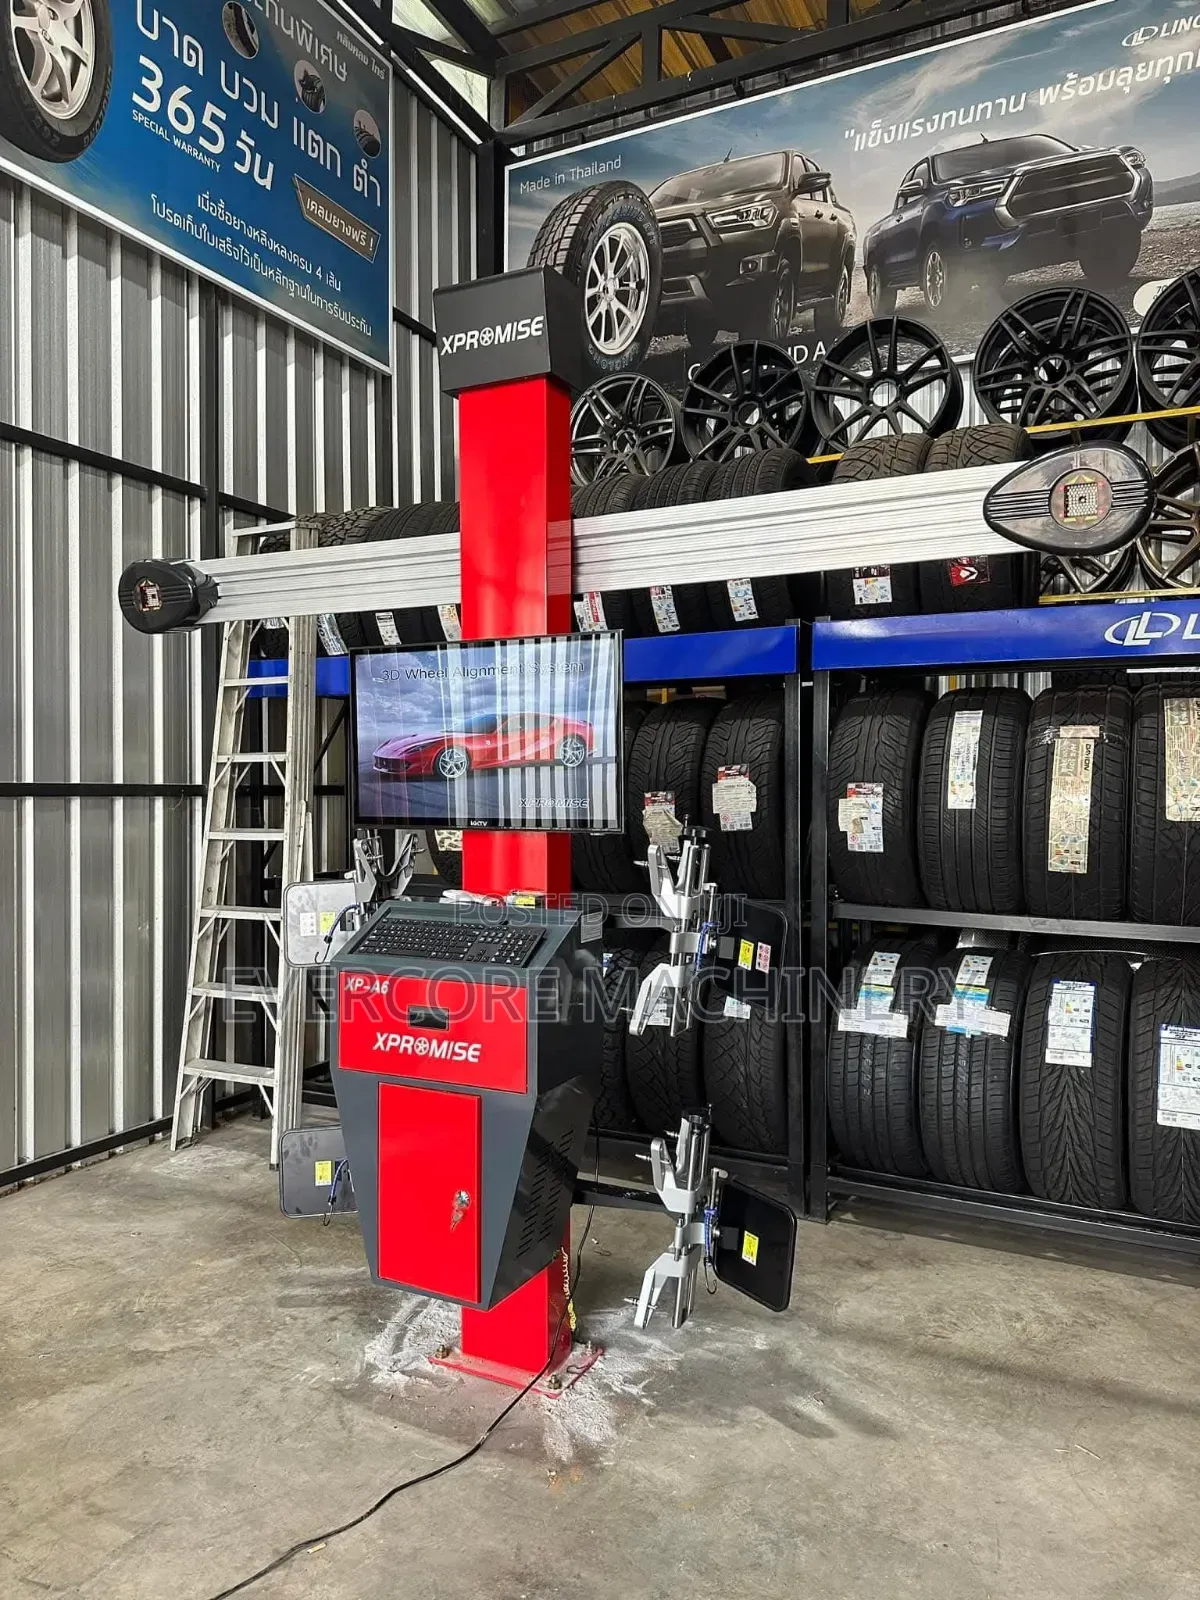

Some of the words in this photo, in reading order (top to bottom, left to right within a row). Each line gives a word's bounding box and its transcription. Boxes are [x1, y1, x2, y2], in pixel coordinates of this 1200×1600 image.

[132, 55, 226, 154] 365
[234, 129, 274, 191] วัน
[132, 109, 171, 142] SPECIAL
[173, 135, 221, 173] WARRANTY
[220, 60, 279, 129] บวม
[293, 116, 341, 178] แตก
[353, 158, 381, 207] ตำ
[519, 175, 551, 195] Made
[554, 172, 565, 186] in
[570, 154, 622, 182] Thailand
[306, 198, 367, 247] เคลมยางฟรี
[316, 266, 323, 280] 4
[440, 314, 544, 356] XPROMISE
[382, 669, 400, 682] 3D
[406, 666, 448, 681] Wheel
[453, 663, 524, 680] Alignment
[529, 660, 584, 677] System
[519, 798, 589, 809] XPROMISE
[344, 976, 390, 995] XP-A6
[372, 1032, 482, 1064] XPROMISE
